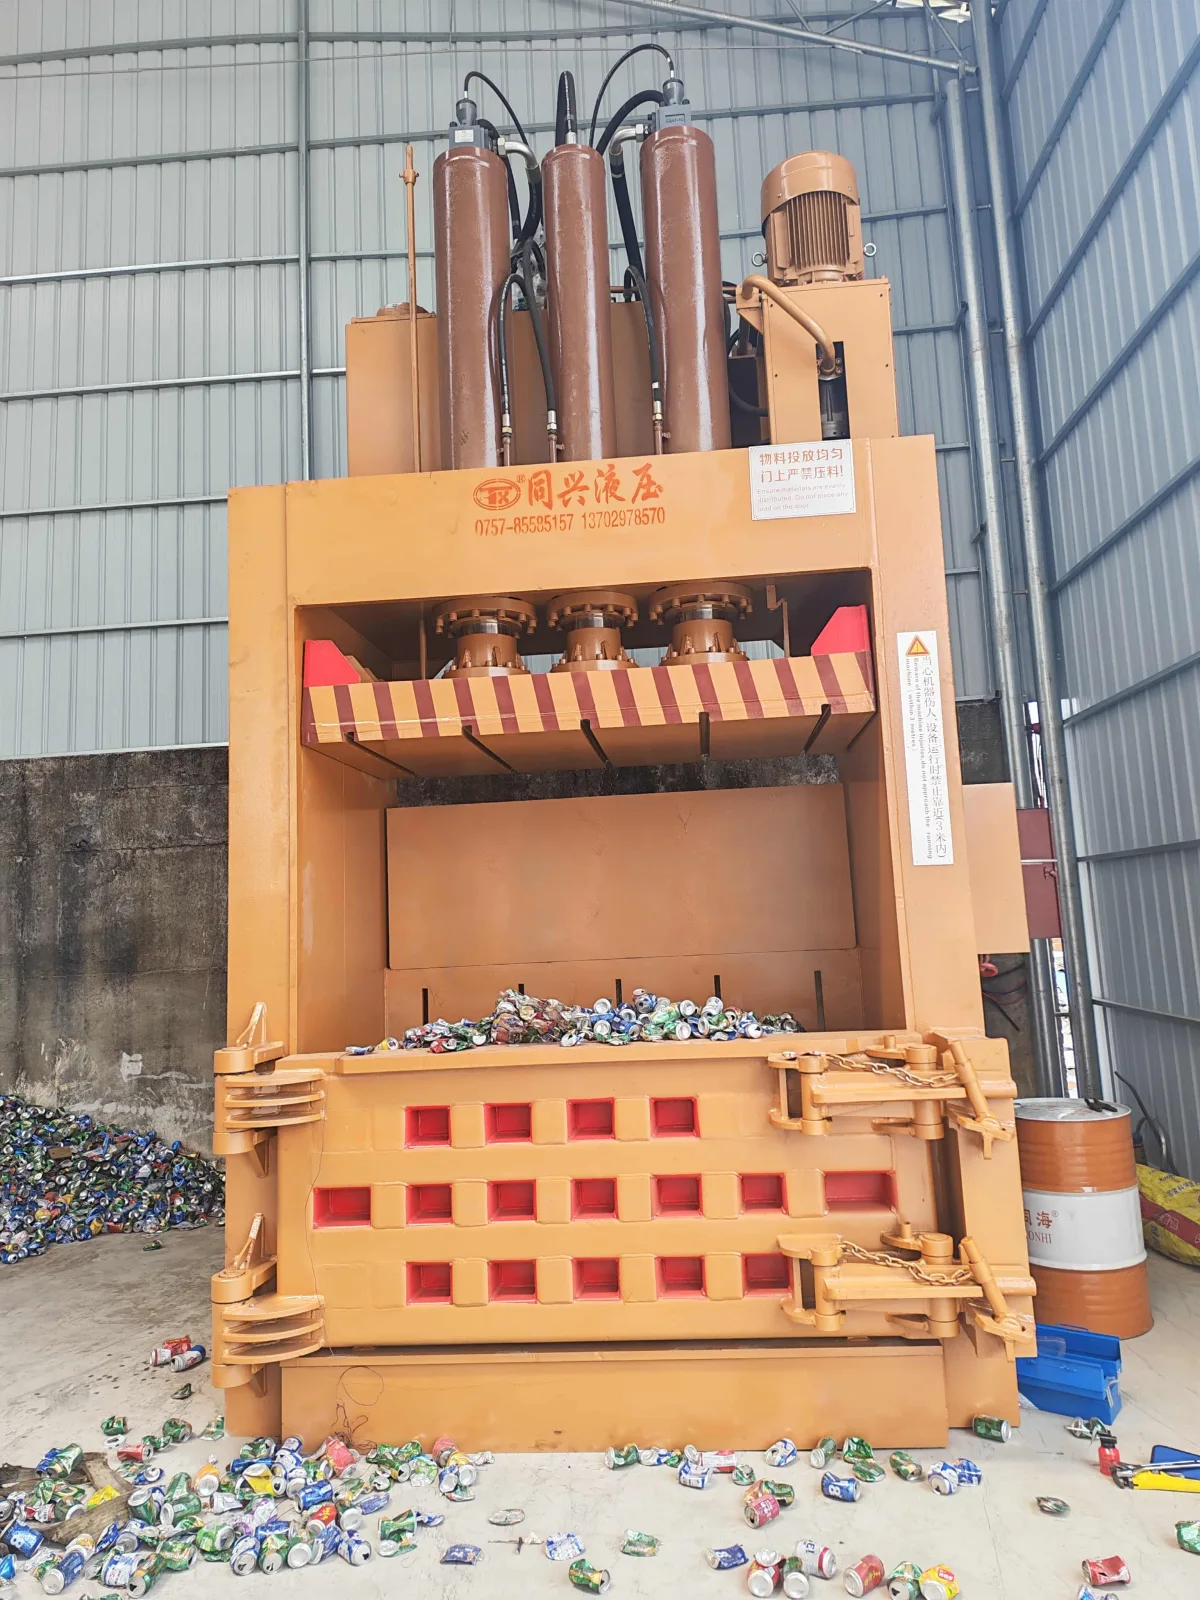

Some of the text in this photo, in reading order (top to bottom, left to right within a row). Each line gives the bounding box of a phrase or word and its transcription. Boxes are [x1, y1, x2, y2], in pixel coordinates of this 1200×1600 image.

[759, 448, 843, 466] 物料投放均匀
[528, 463, 664, 511] 同兴液压
[760, 465, 844, 483] 门上严禁压料!
[757, 495, 793, 503] distributed.
[781, 485, 811, 494] materials
[475, 506, 666, 536] 0757-85585157 13702978570
[916, 703, 924, 732] machine
[921, 783, 930, 814] approach
[925, 832, 933, 859] running
